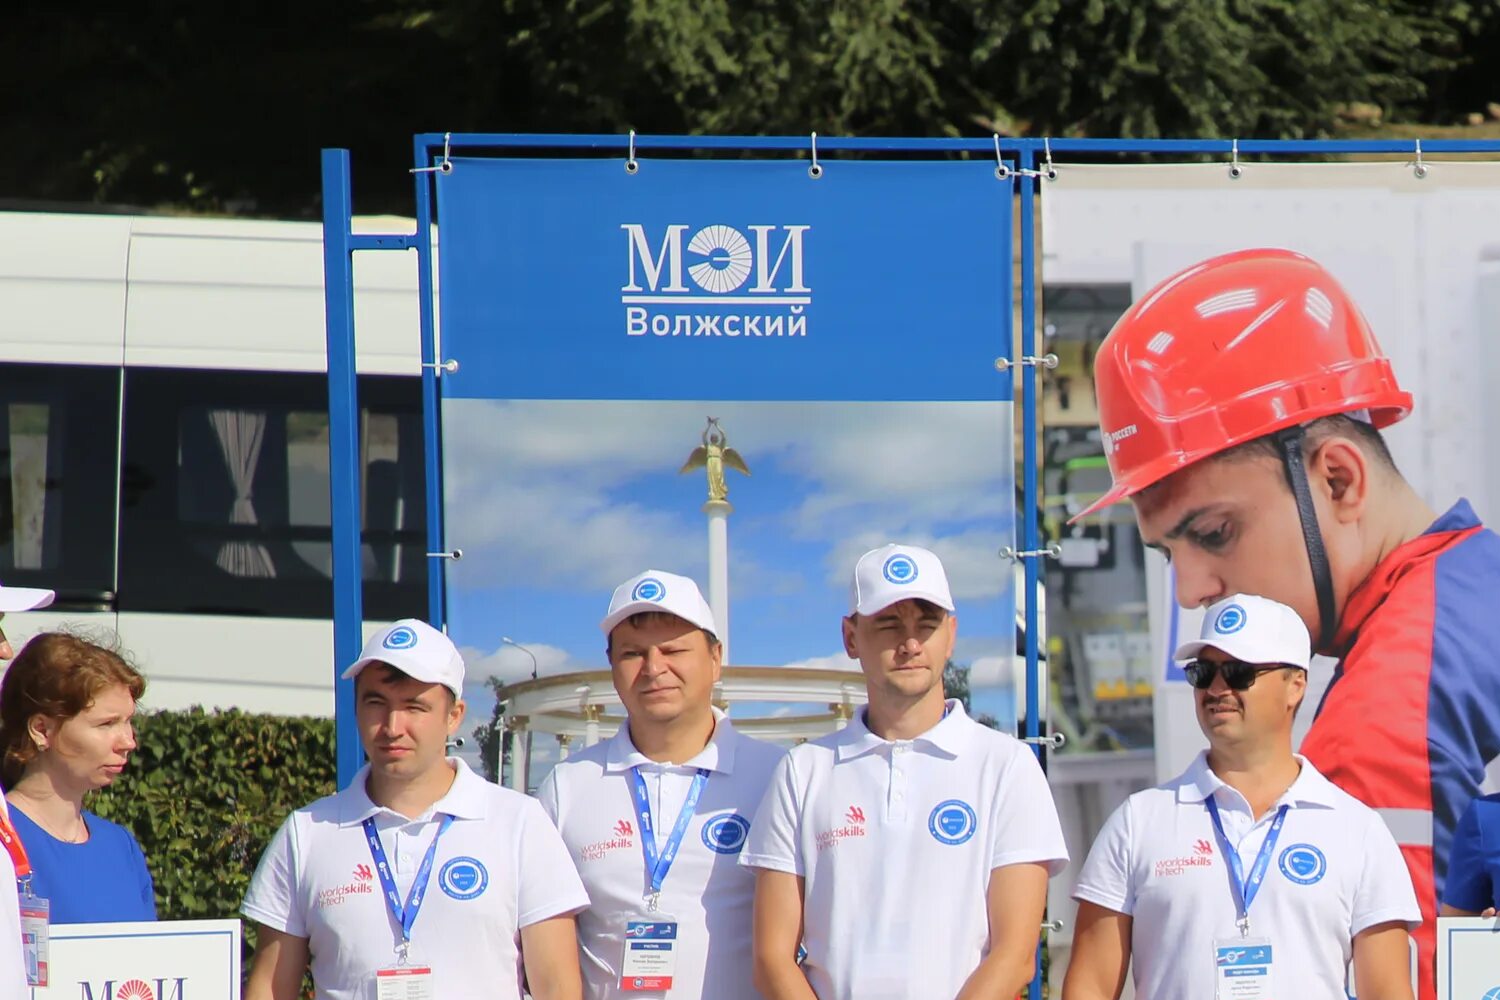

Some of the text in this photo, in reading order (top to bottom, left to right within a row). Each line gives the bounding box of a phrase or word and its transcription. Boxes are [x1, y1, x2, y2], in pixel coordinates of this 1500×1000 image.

[620, 223, 811, 293] МЭИ
[626, 305, 807, 336] Волжский
[581, 838, 632, 853] worldskills
[1155, 857, 1212, 868] worldskills
[318, 883, 373, 899] worldskills
